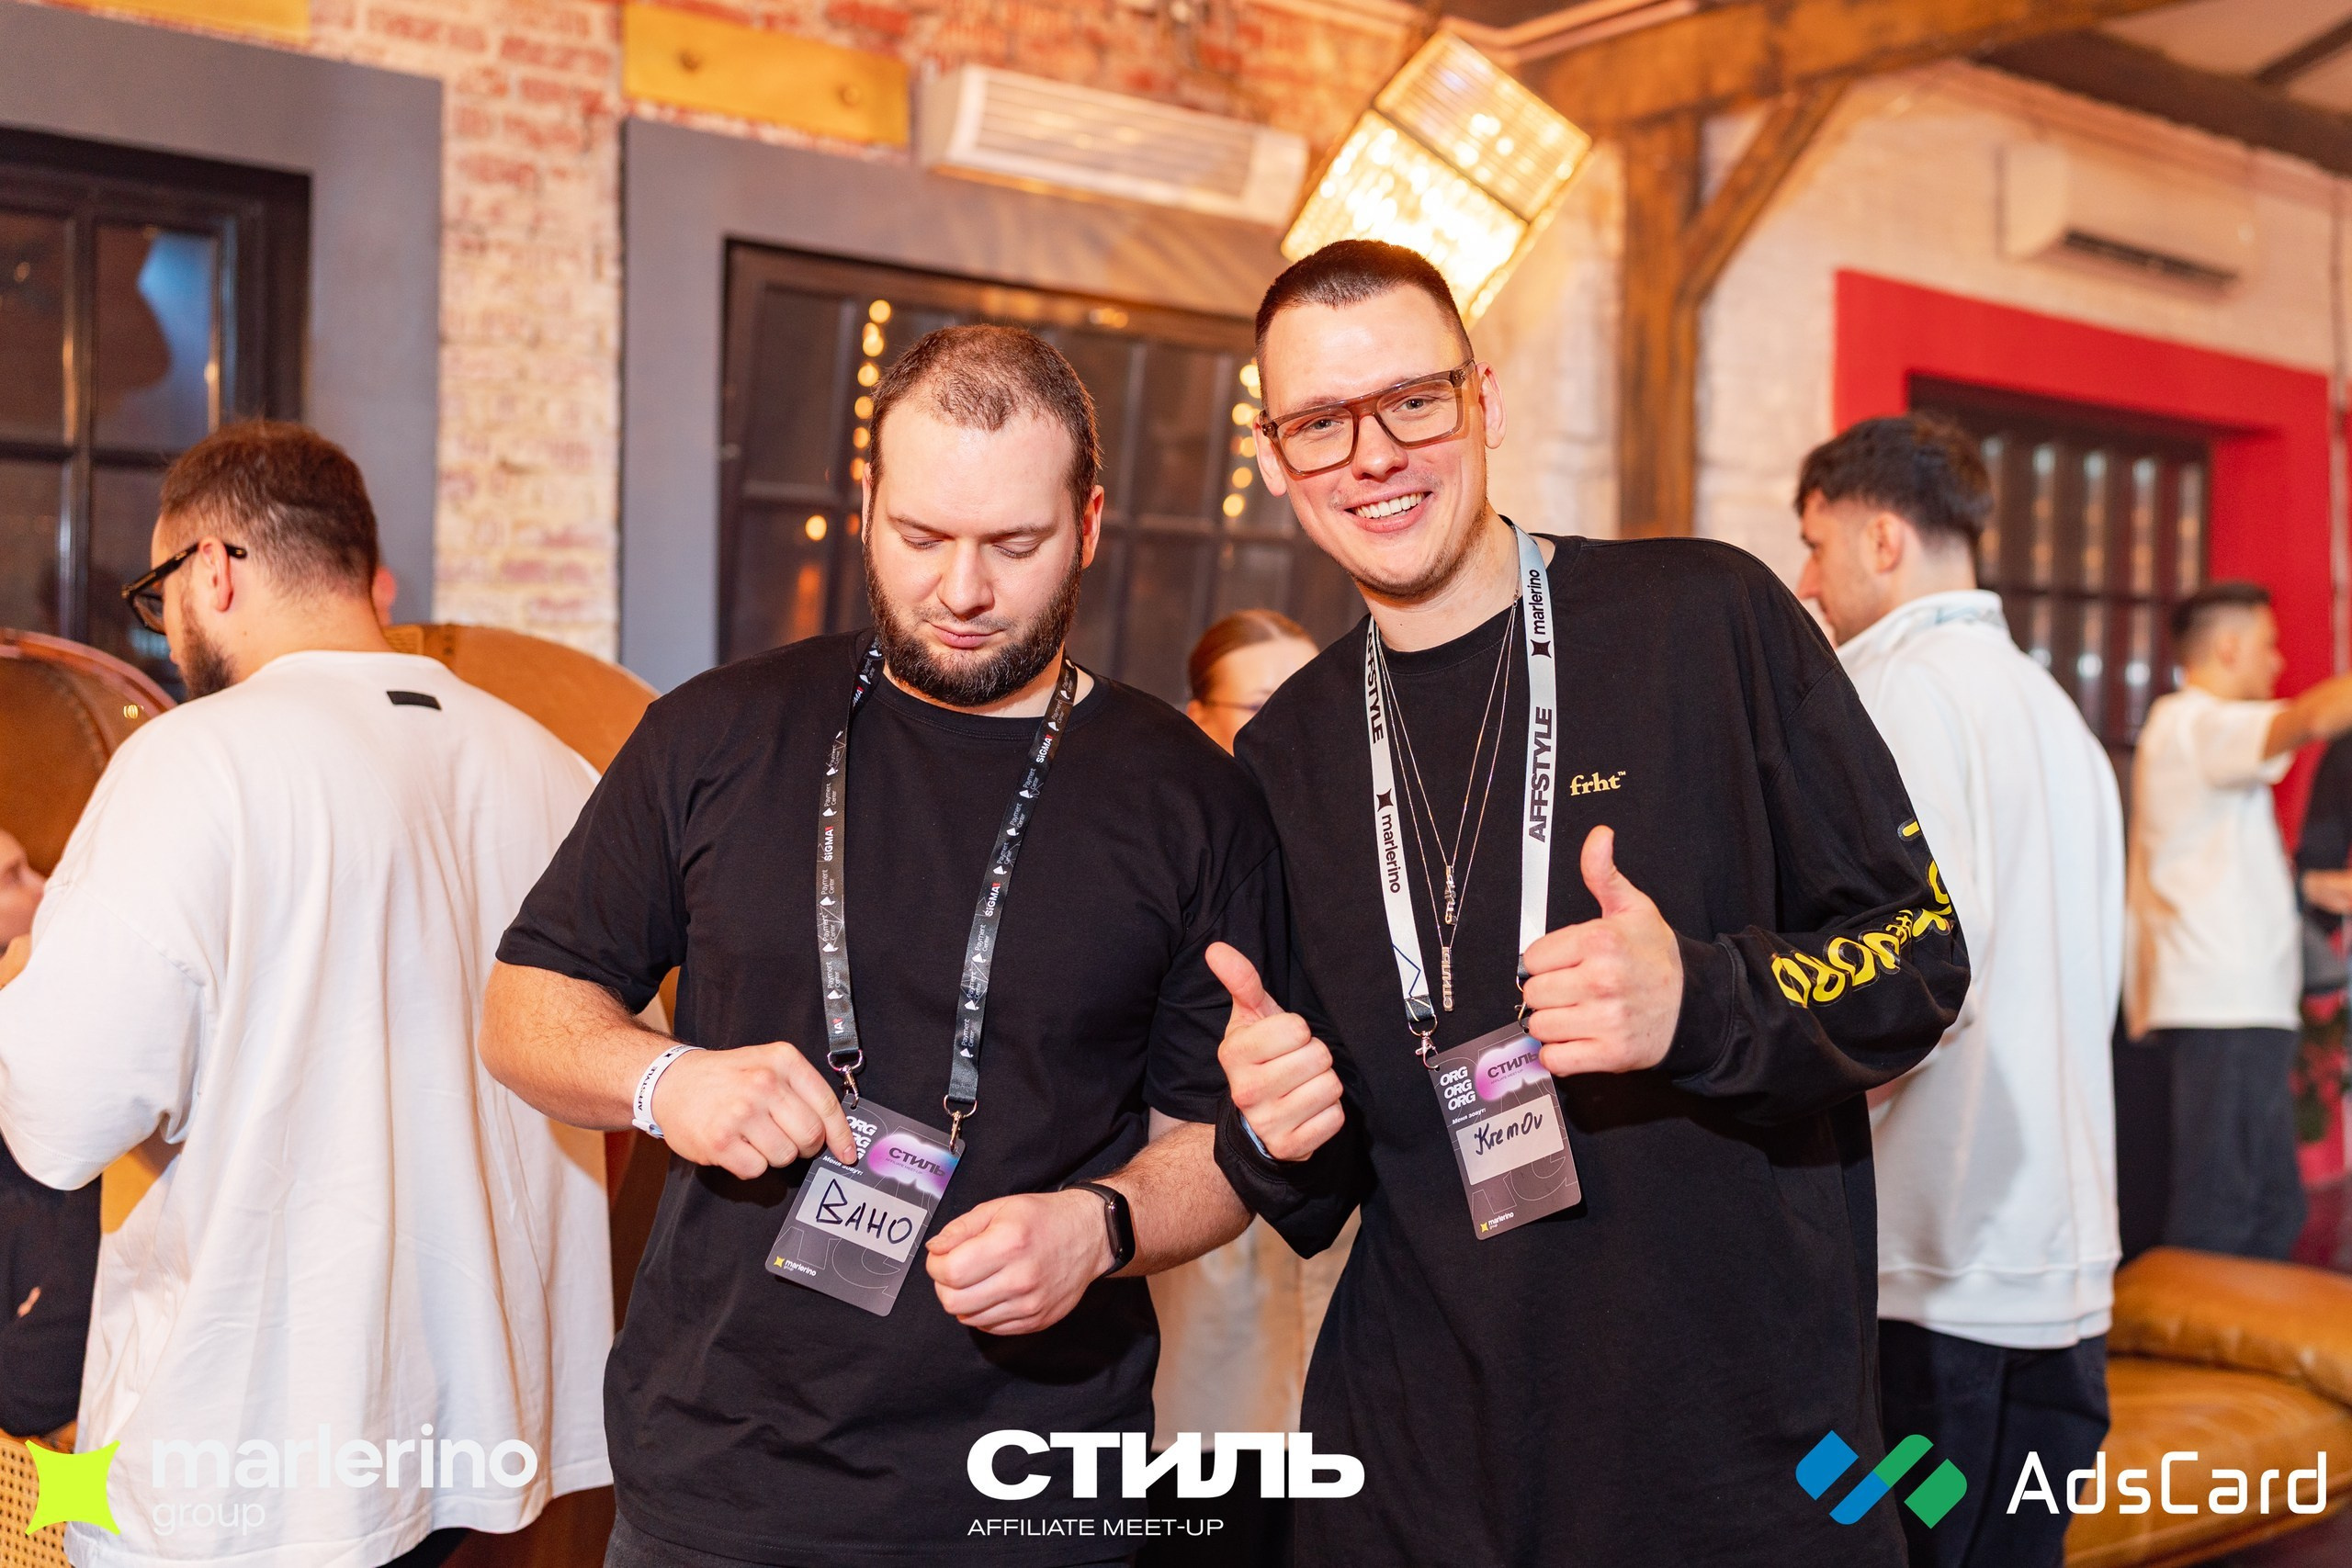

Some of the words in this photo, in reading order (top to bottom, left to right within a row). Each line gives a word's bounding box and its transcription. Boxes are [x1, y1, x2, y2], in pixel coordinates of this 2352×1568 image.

[1528, 570, 1546, 635] marlerino
[1367, 631, 1385, 745] AFFSTYLE
[1527, 706, 1553, 843] AFFSTYLE
[1381, 813, 1402, 894] marlerino
[1440, 1066, 1469, 1087] ORG
[1487, 1052, 1540, 1079] СТИЛЬ
[1444, 1078, 1473, 1100] ORG
[1448, 1090, 1476, 1111] ORG
[888, 1147, 946, 1178] СТИЛЬ
